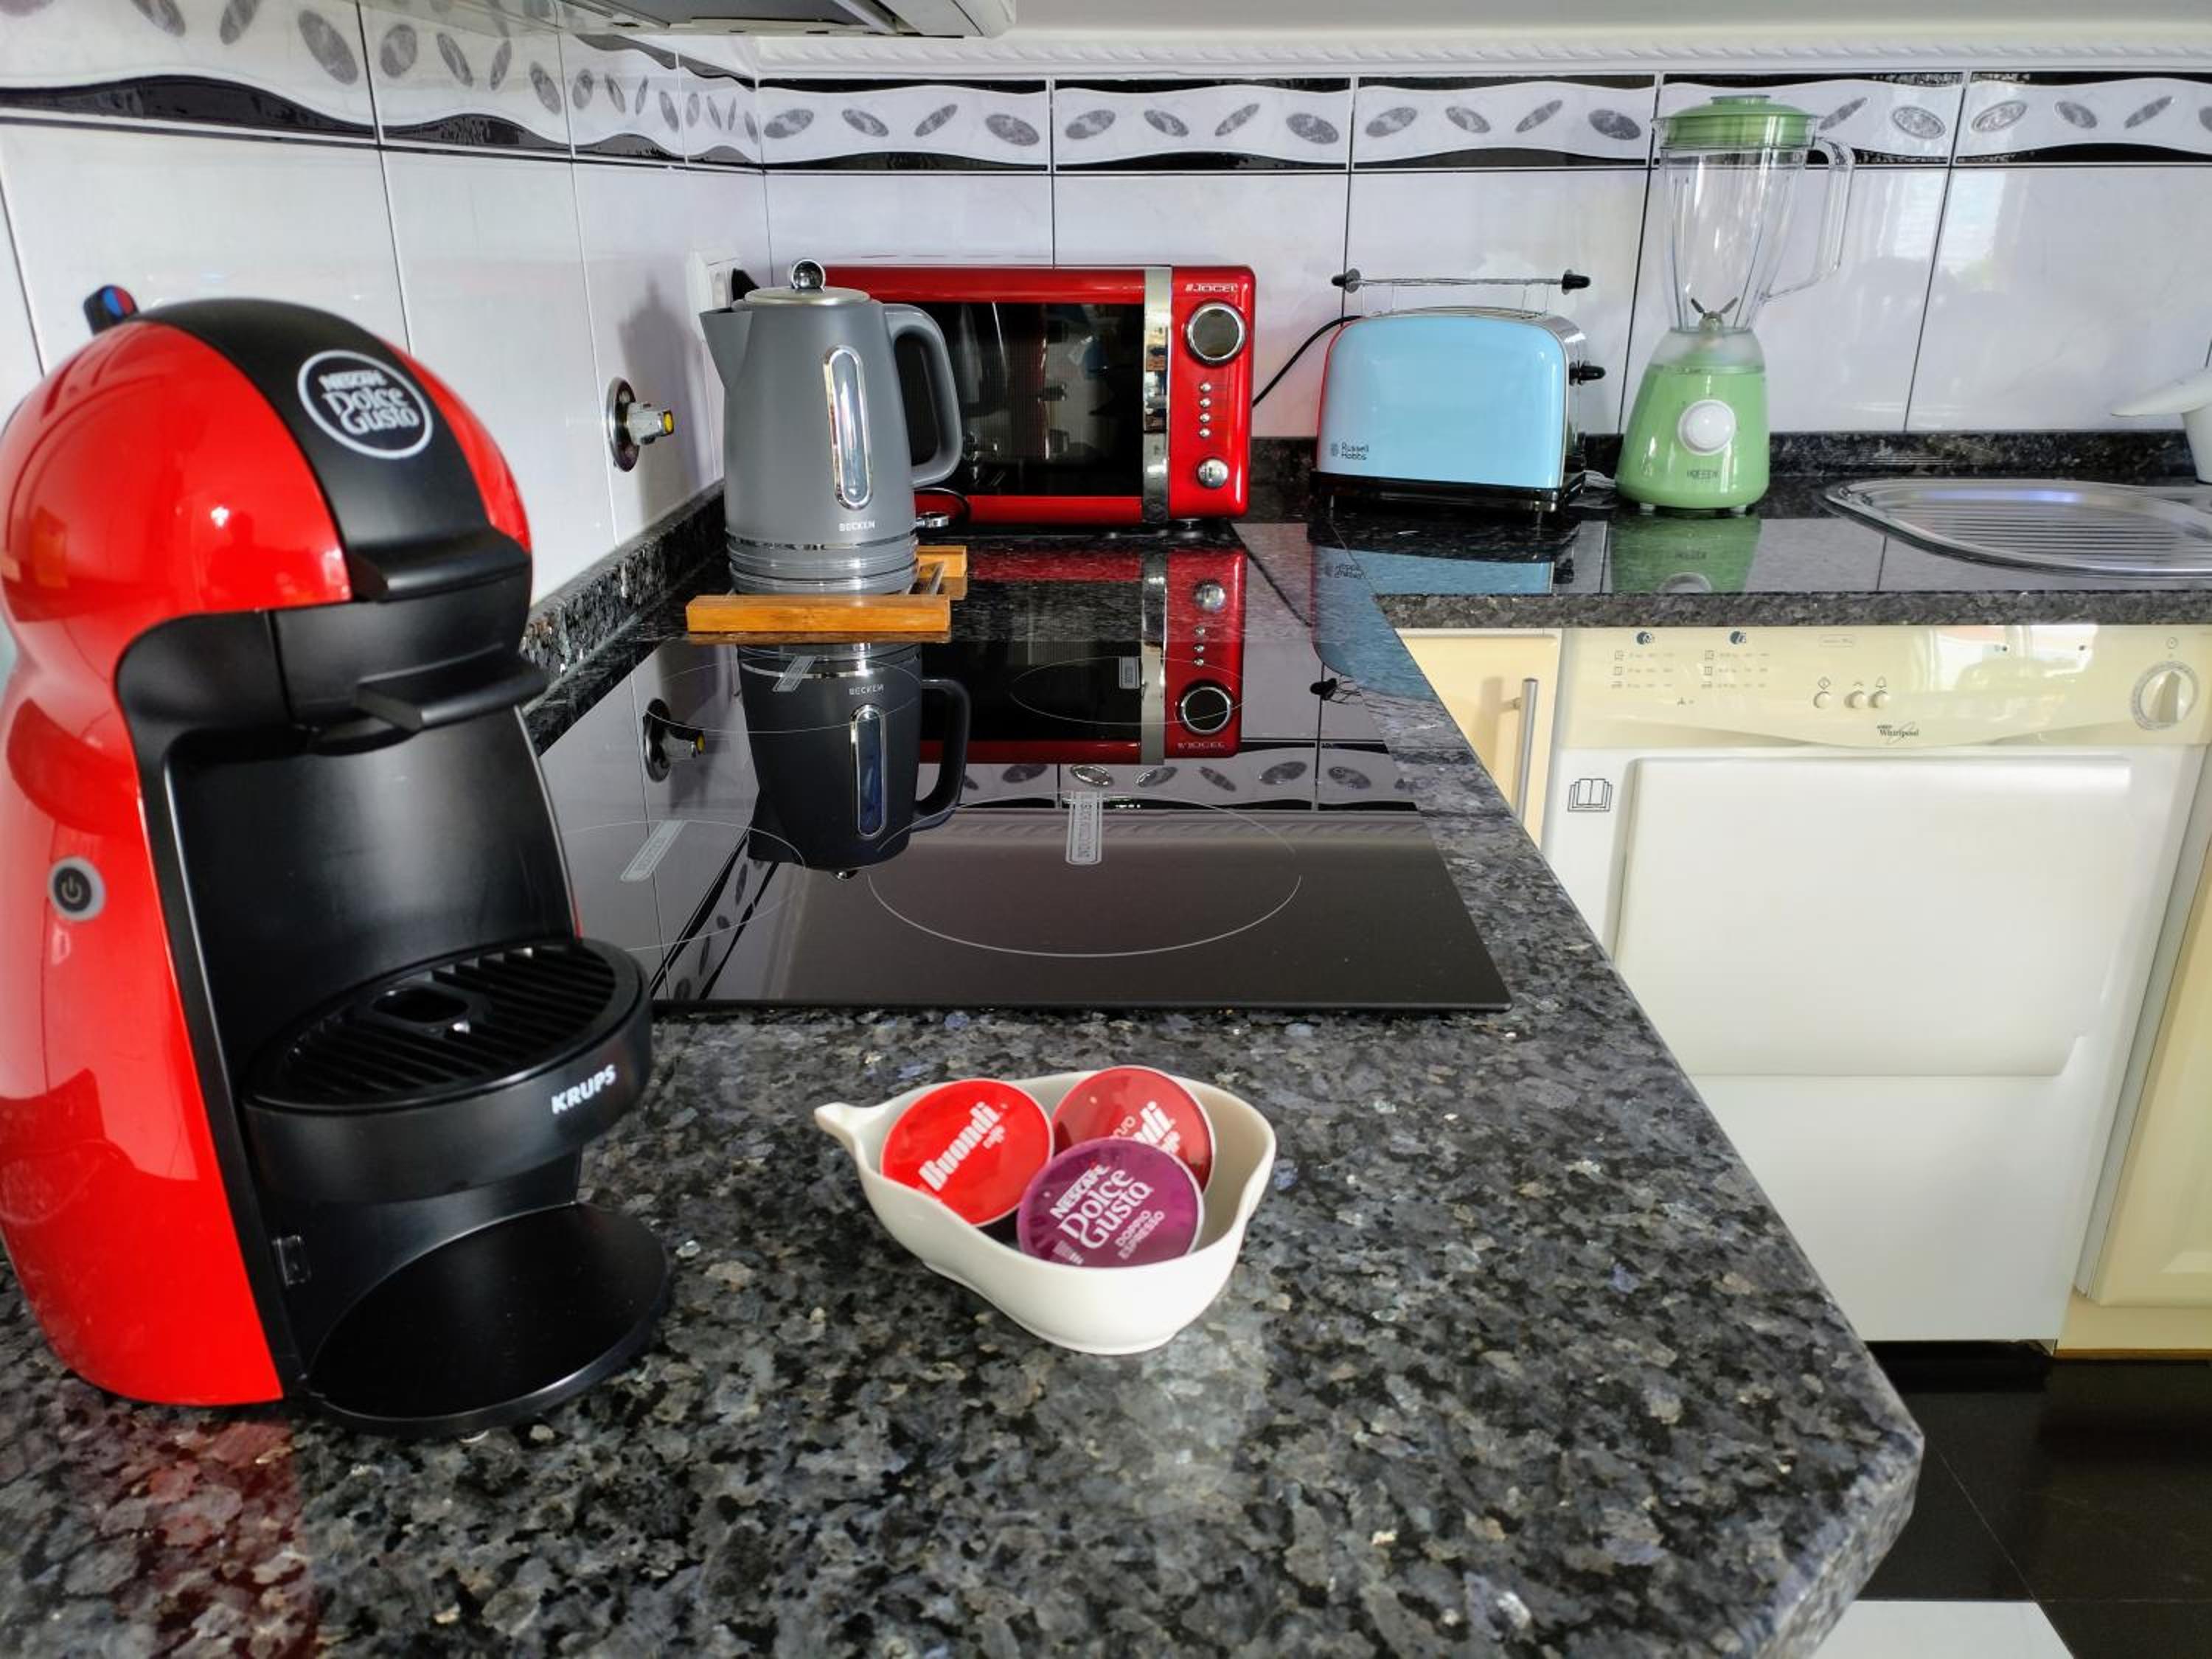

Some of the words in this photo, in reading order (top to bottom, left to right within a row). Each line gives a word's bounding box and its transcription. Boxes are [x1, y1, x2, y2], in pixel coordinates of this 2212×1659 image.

[322, 387, 408, 416] Dolce
[341, 407, 420, 435] Gusto
[838, 521, 876, 532] BECKEN
[552, 1064, 616, 1114] KRUPS
[1057, 1169, 1134, 1239] Dolce
[1079, 1182, 1155, 1249] Gusto
